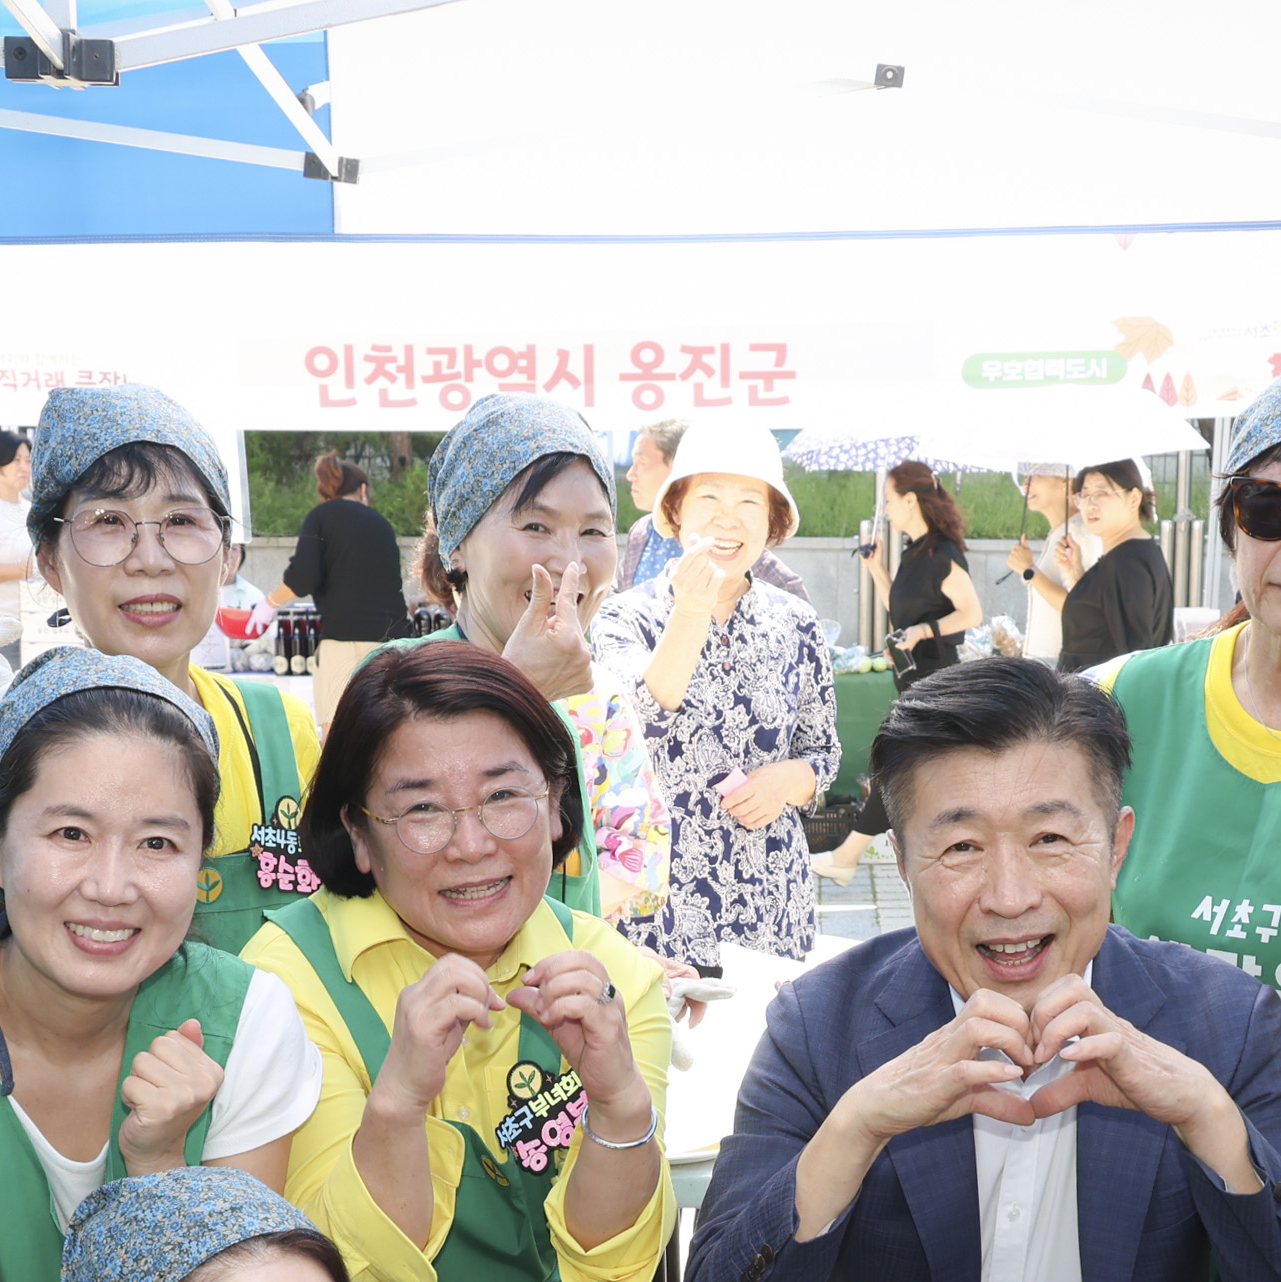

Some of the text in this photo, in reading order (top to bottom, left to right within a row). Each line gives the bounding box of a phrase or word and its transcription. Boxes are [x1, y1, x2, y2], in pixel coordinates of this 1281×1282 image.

[304, 340, 798, 412] 인천광역시 옹진군
[981, 357, 1108, 382] 우호협력도시
[527, 1070, 583, 1118] 부녀회
